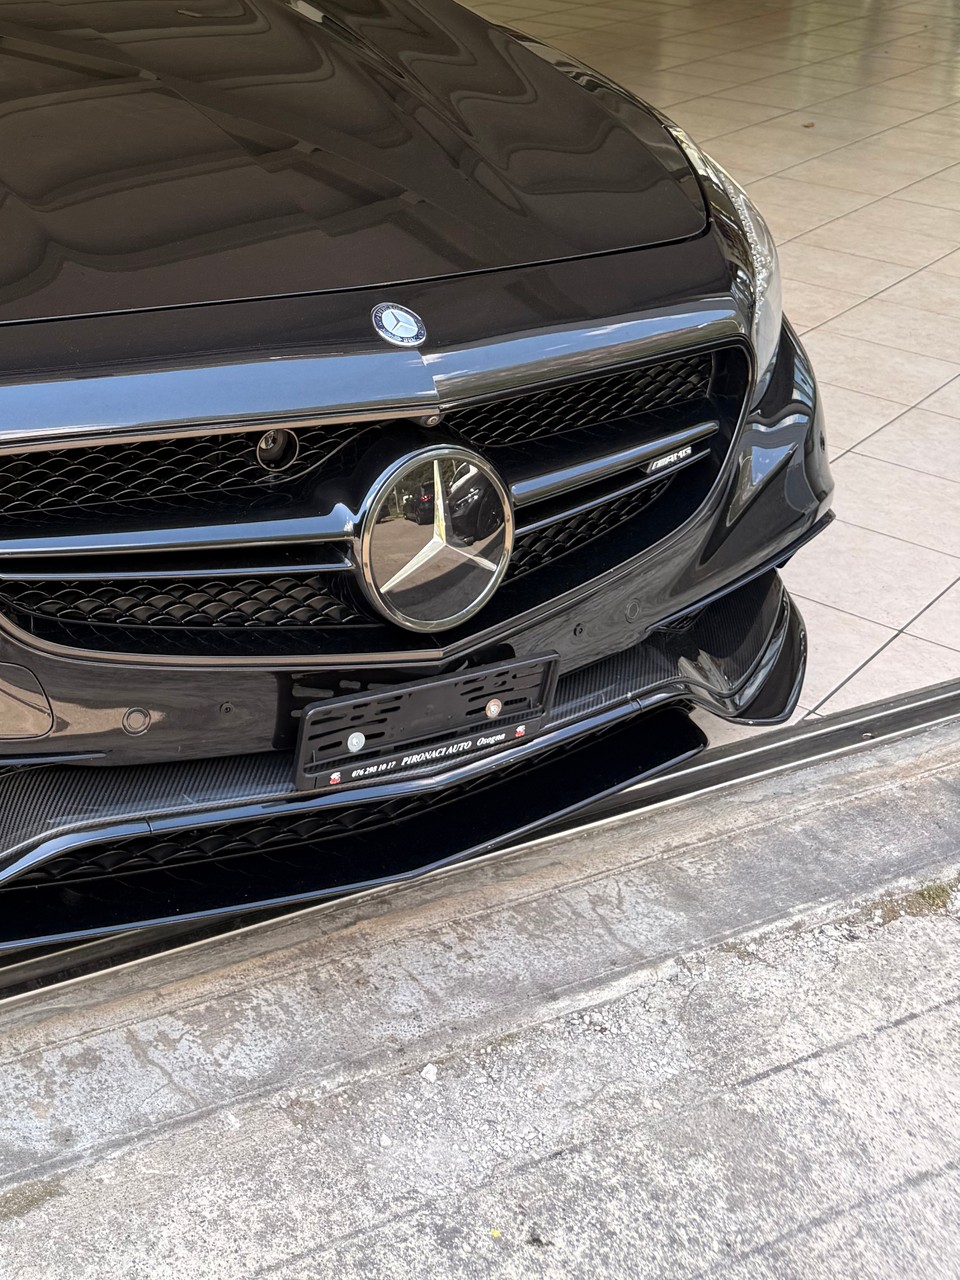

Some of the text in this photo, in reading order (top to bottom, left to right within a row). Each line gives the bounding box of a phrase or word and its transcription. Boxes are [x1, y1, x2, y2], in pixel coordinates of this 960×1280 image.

[400, 746, 447, 766] PIRONACI
[445, 740, 473, 755] AUTO
[476, 733, 506, 746] Osogna
